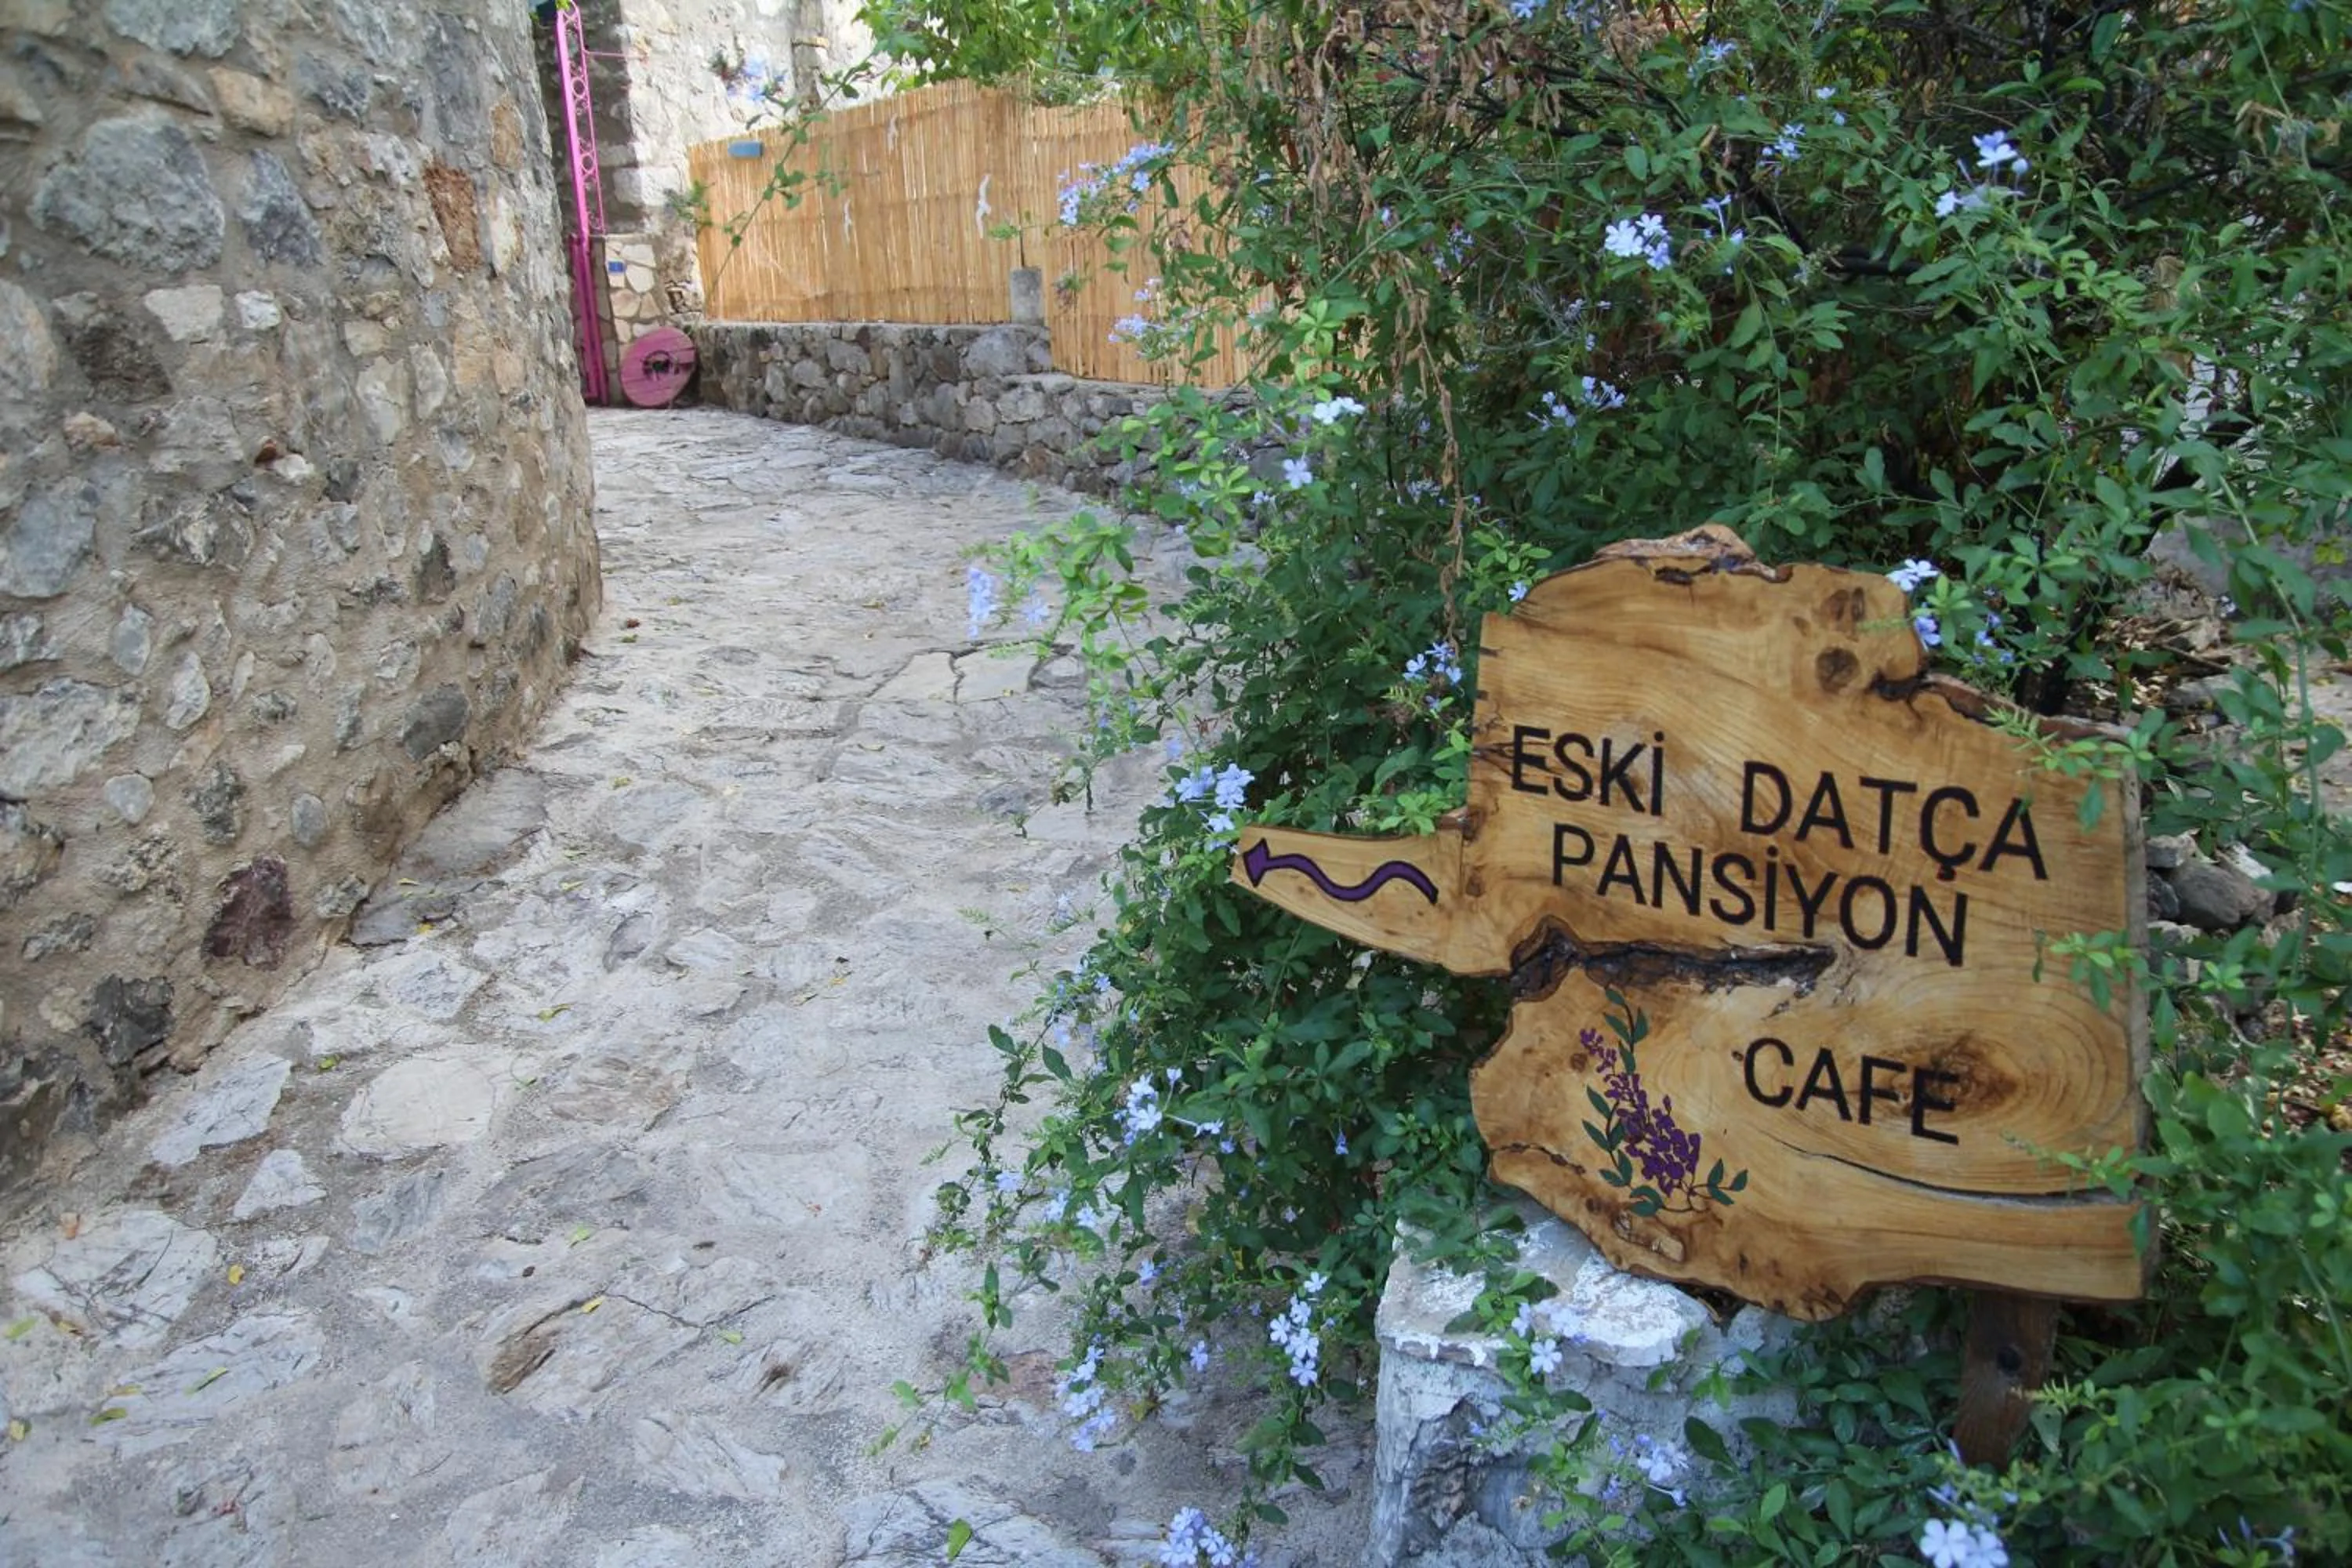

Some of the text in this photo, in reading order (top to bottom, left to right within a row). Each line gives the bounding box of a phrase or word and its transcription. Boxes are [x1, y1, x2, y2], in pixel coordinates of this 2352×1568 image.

[1510, 724, 2049, 881] ESKİ DATÇA
[1552, 822, 1969, 967] PANSİYON
[1743, 1036, 1960, 1145] CAFE
